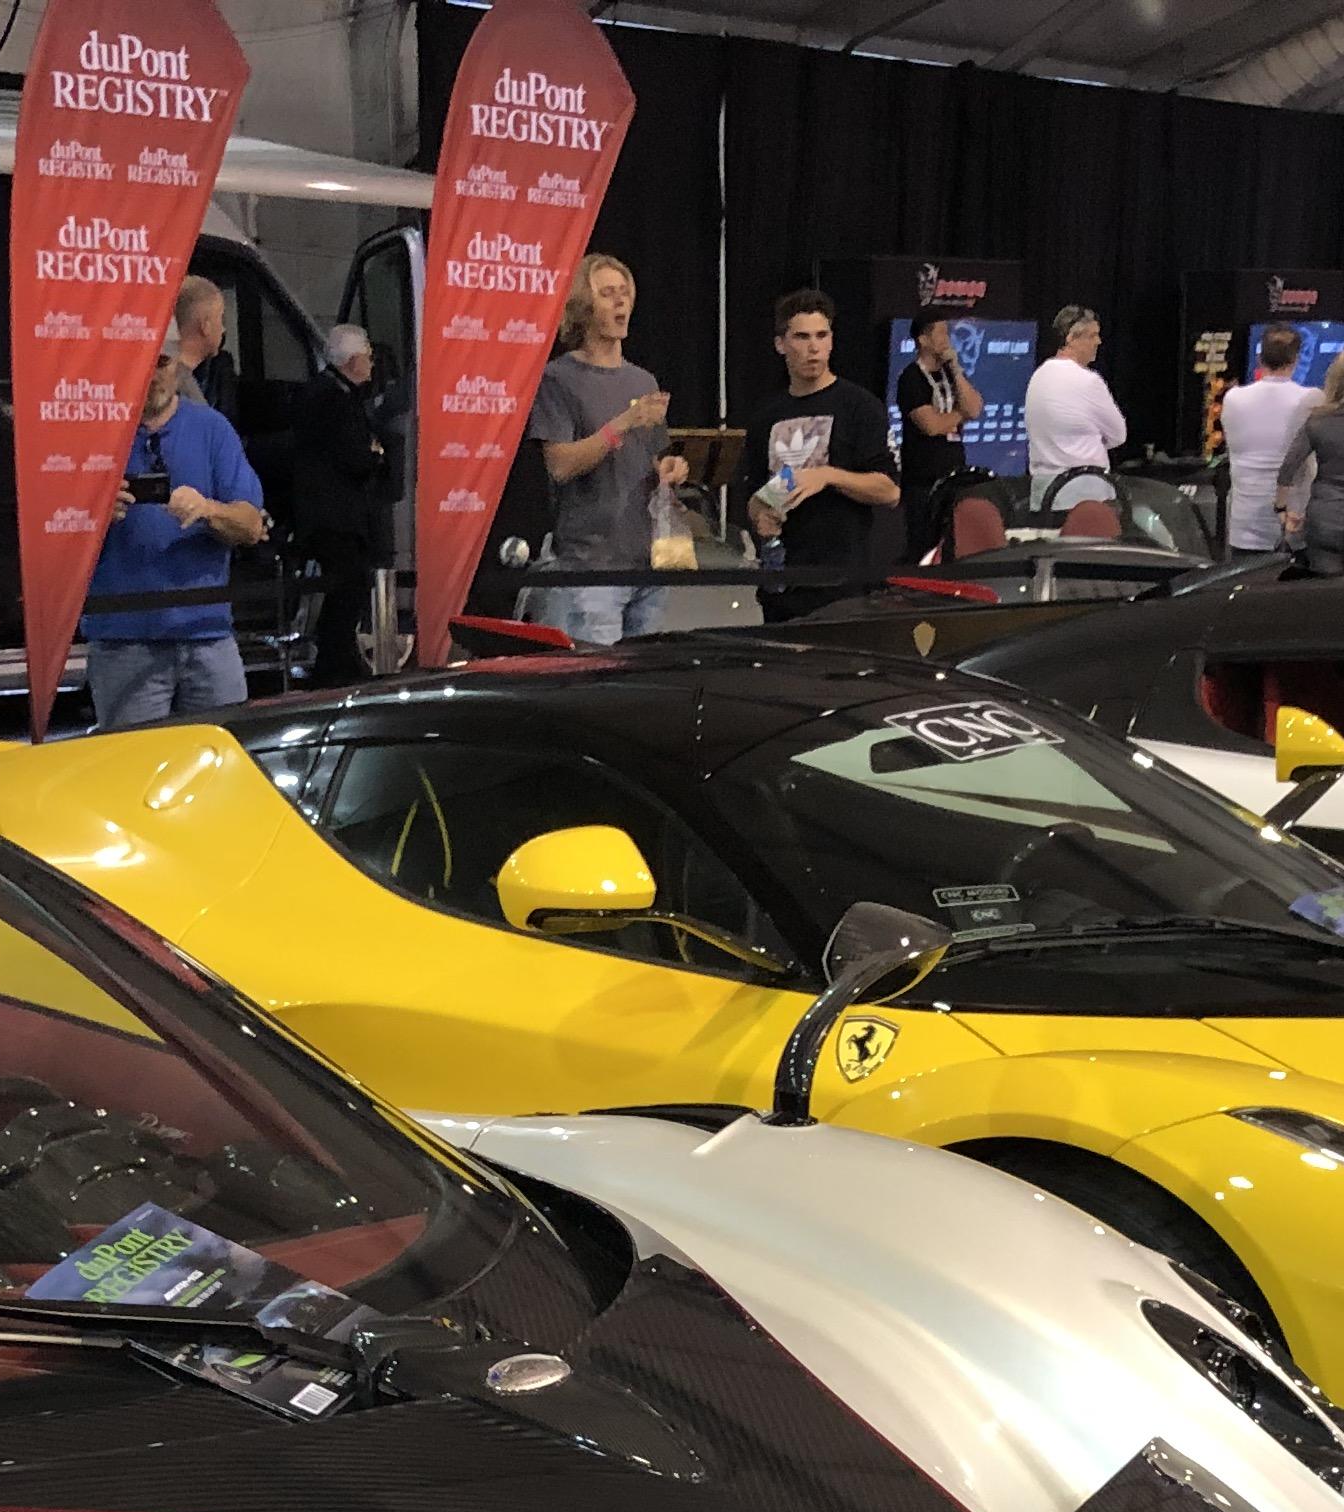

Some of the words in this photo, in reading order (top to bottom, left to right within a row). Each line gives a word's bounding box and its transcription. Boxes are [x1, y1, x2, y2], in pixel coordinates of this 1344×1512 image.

[80, 29, 191, 81] duPont
[51, 71, 218, 122] REGISTRY
[494, 67, 587, 114] duPont
[470, 103, 609, 151] REGISTRY
[50, 138, 102, 162] duPont
[38, 158, 116, 182] REGISTRY
[58, 215, 150, 252] duPont
[467, 231, 543, 266] duPont
[36, 250, 171, 285] REGISTRY
[446, 260, 560, 295] REGISTRY
[54, 378, 115, 400] duPont
[40, 401, 134, 422] REGISTRY
[916, 710, 1041, 747] CNC
[74, 1227, 155, 1281] duPont
[82, 1227, 194, 1304] REGISTRY
